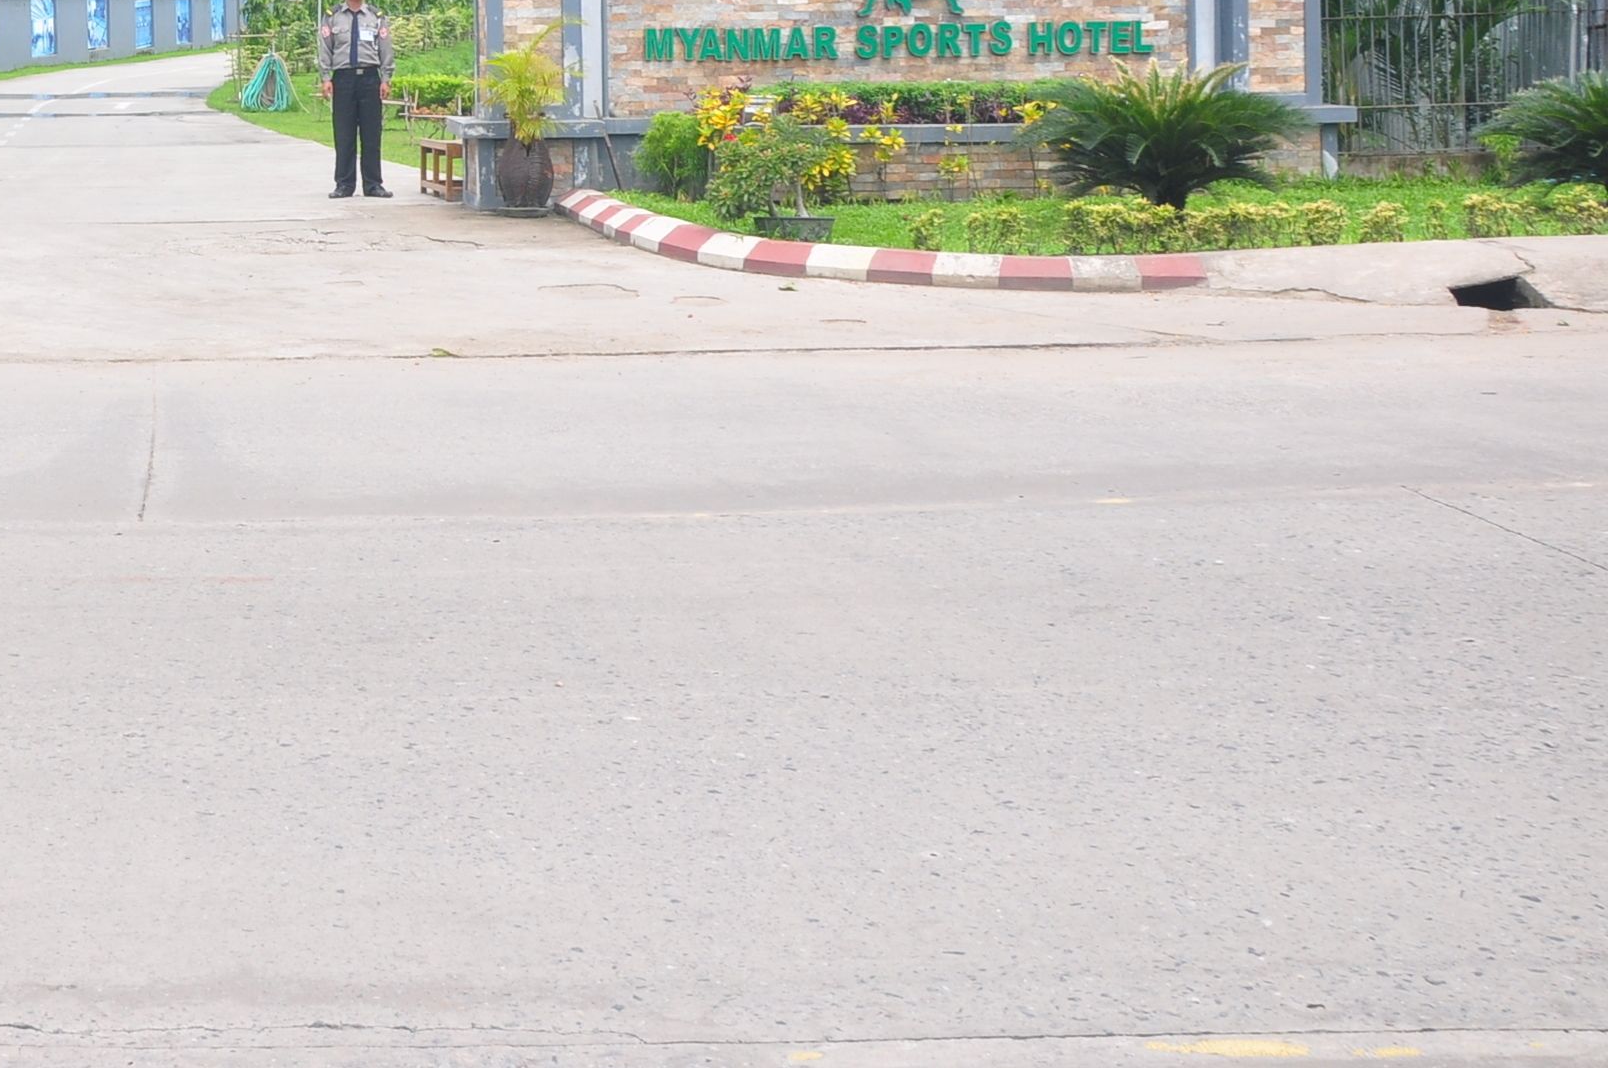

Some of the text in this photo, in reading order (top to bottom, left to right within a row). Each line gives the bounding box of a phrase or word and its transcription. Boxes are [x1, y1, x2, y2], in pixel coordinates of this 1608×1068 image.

[644, 20, 1155, 62] MYANMAR SPORTS HOTEL
